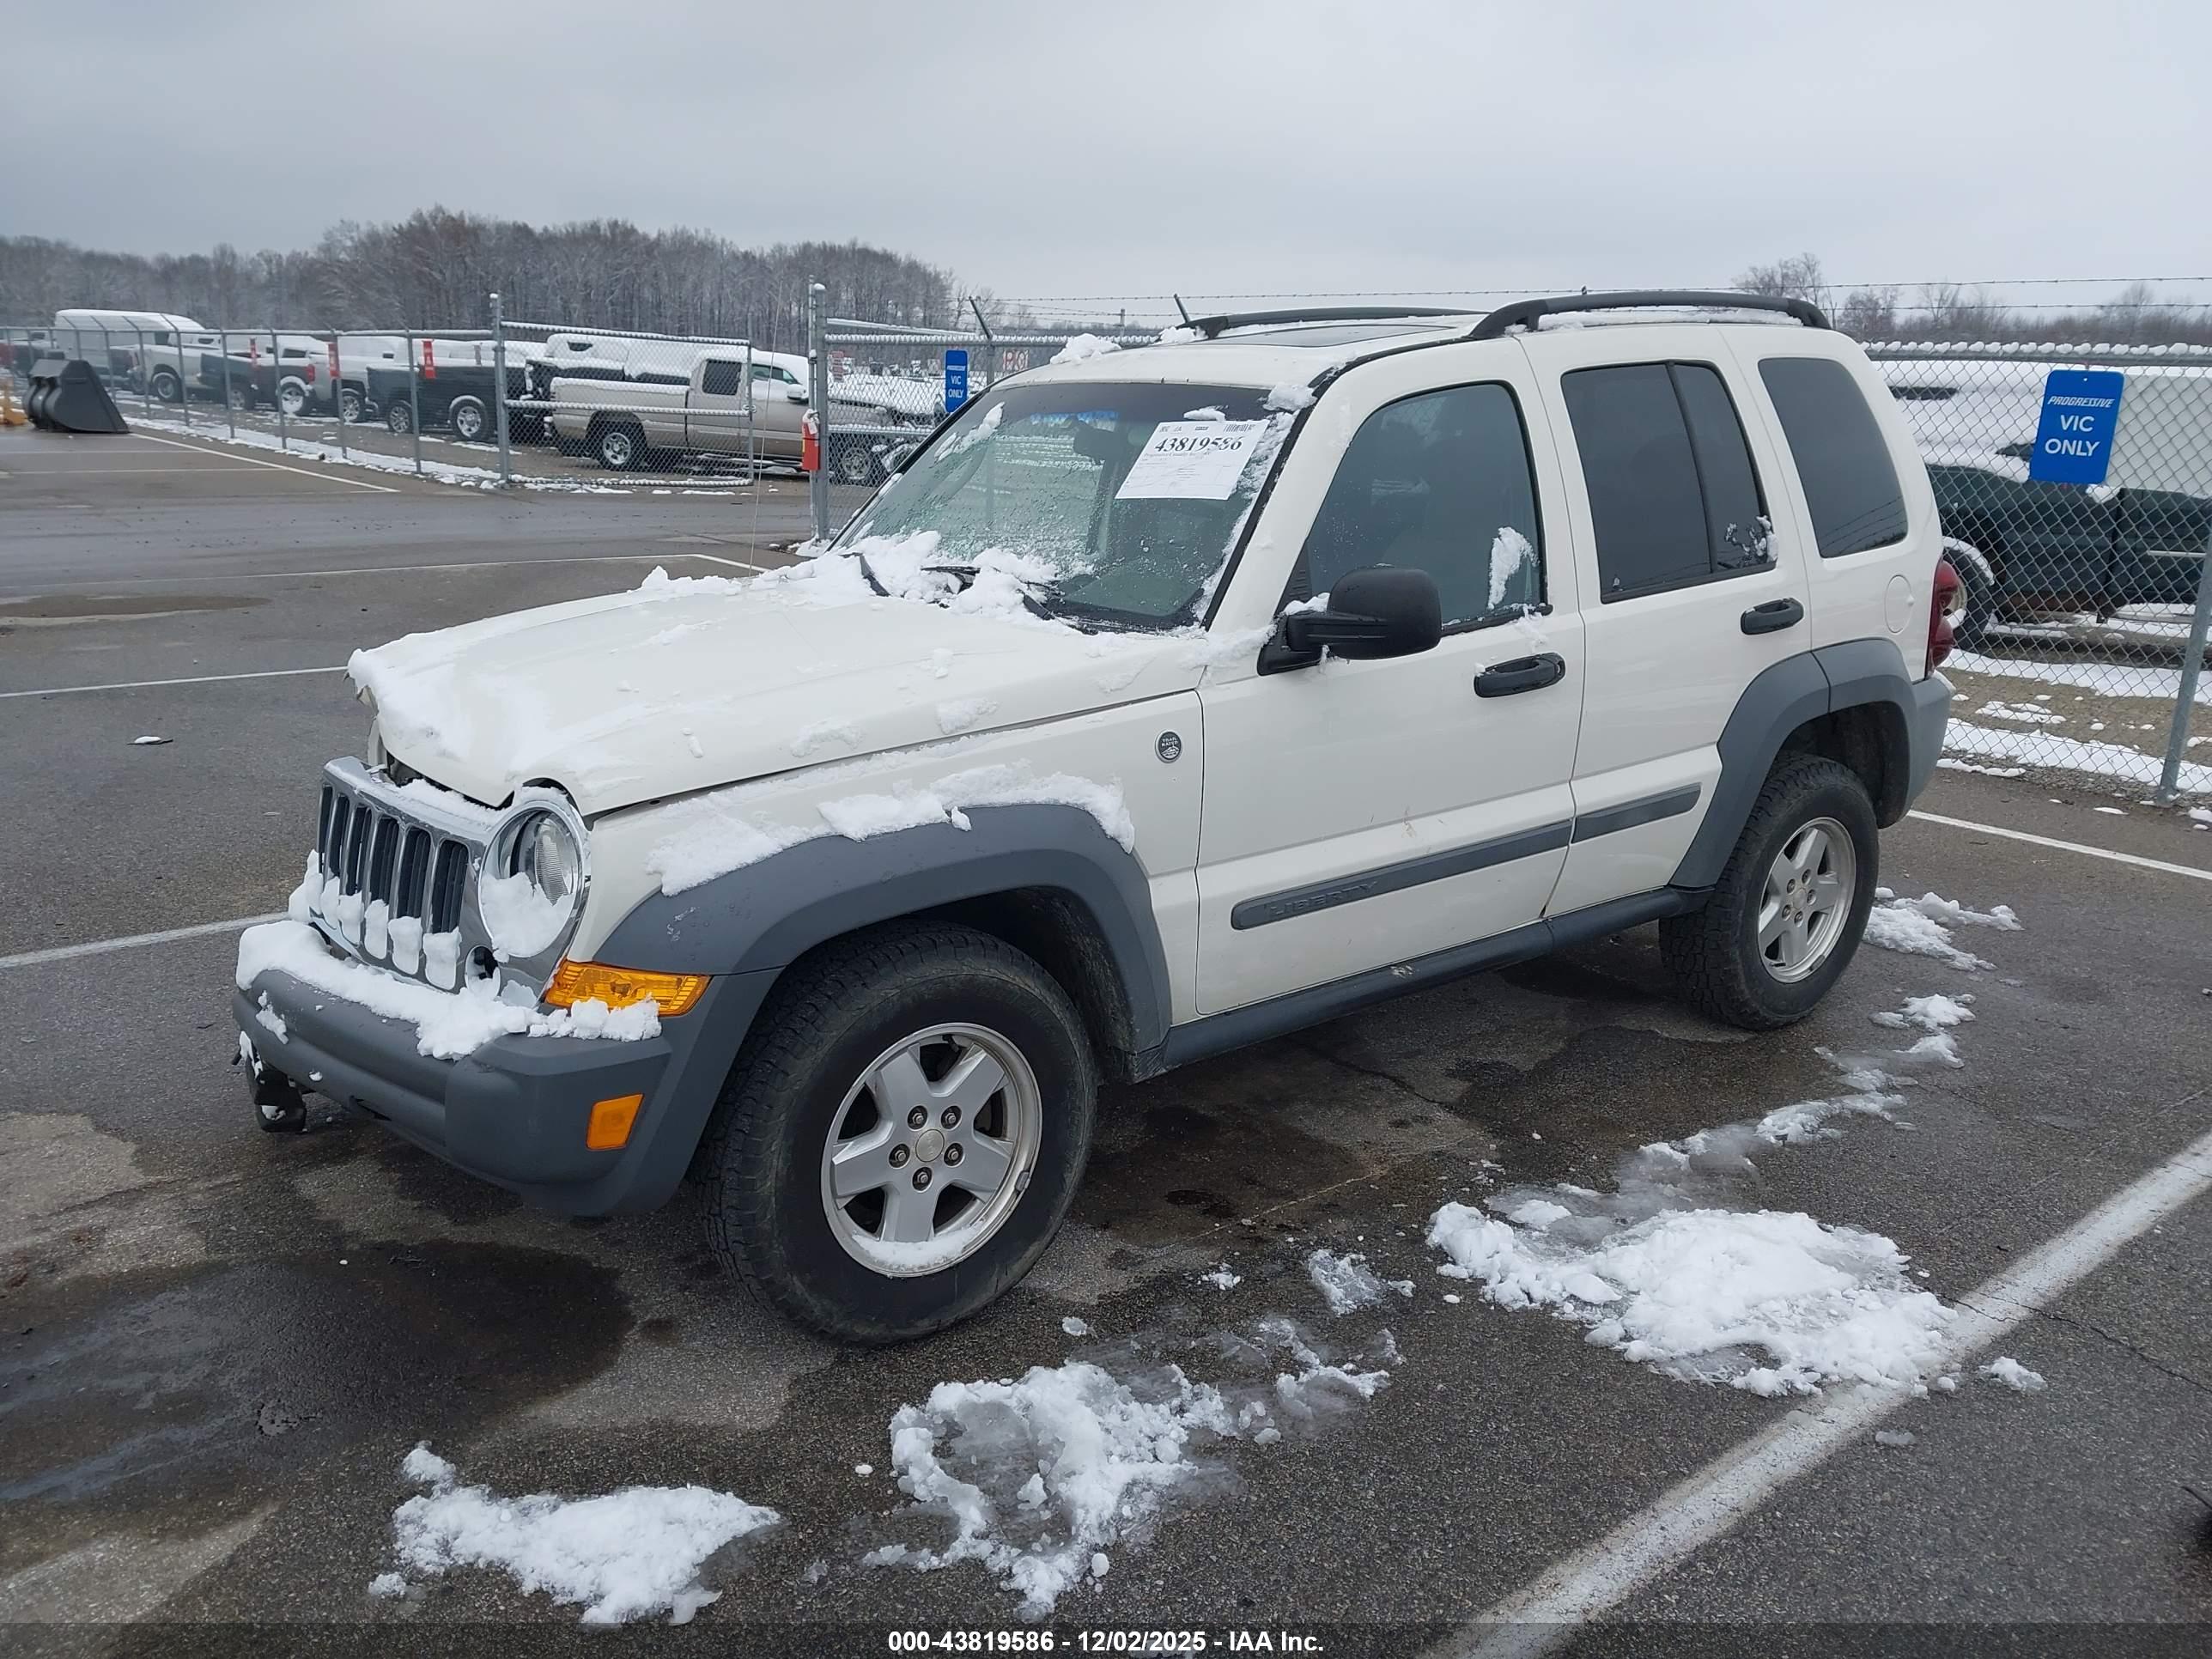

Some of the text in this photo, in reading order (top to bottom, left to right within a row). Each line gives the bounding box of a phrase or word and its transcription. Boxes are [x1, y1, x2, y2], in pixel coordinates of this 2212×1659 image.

[951, 375, 962, 385] VIC
[948, 388, 964, 398] ONLY
[2047, 395, 2116, 408] PROGRESSIVE
[2060, 414, 2094, 432] VIC
[2045, 438, 2100, 457] ONLY
[1270, 881, 1377, 915] LIBERTY
